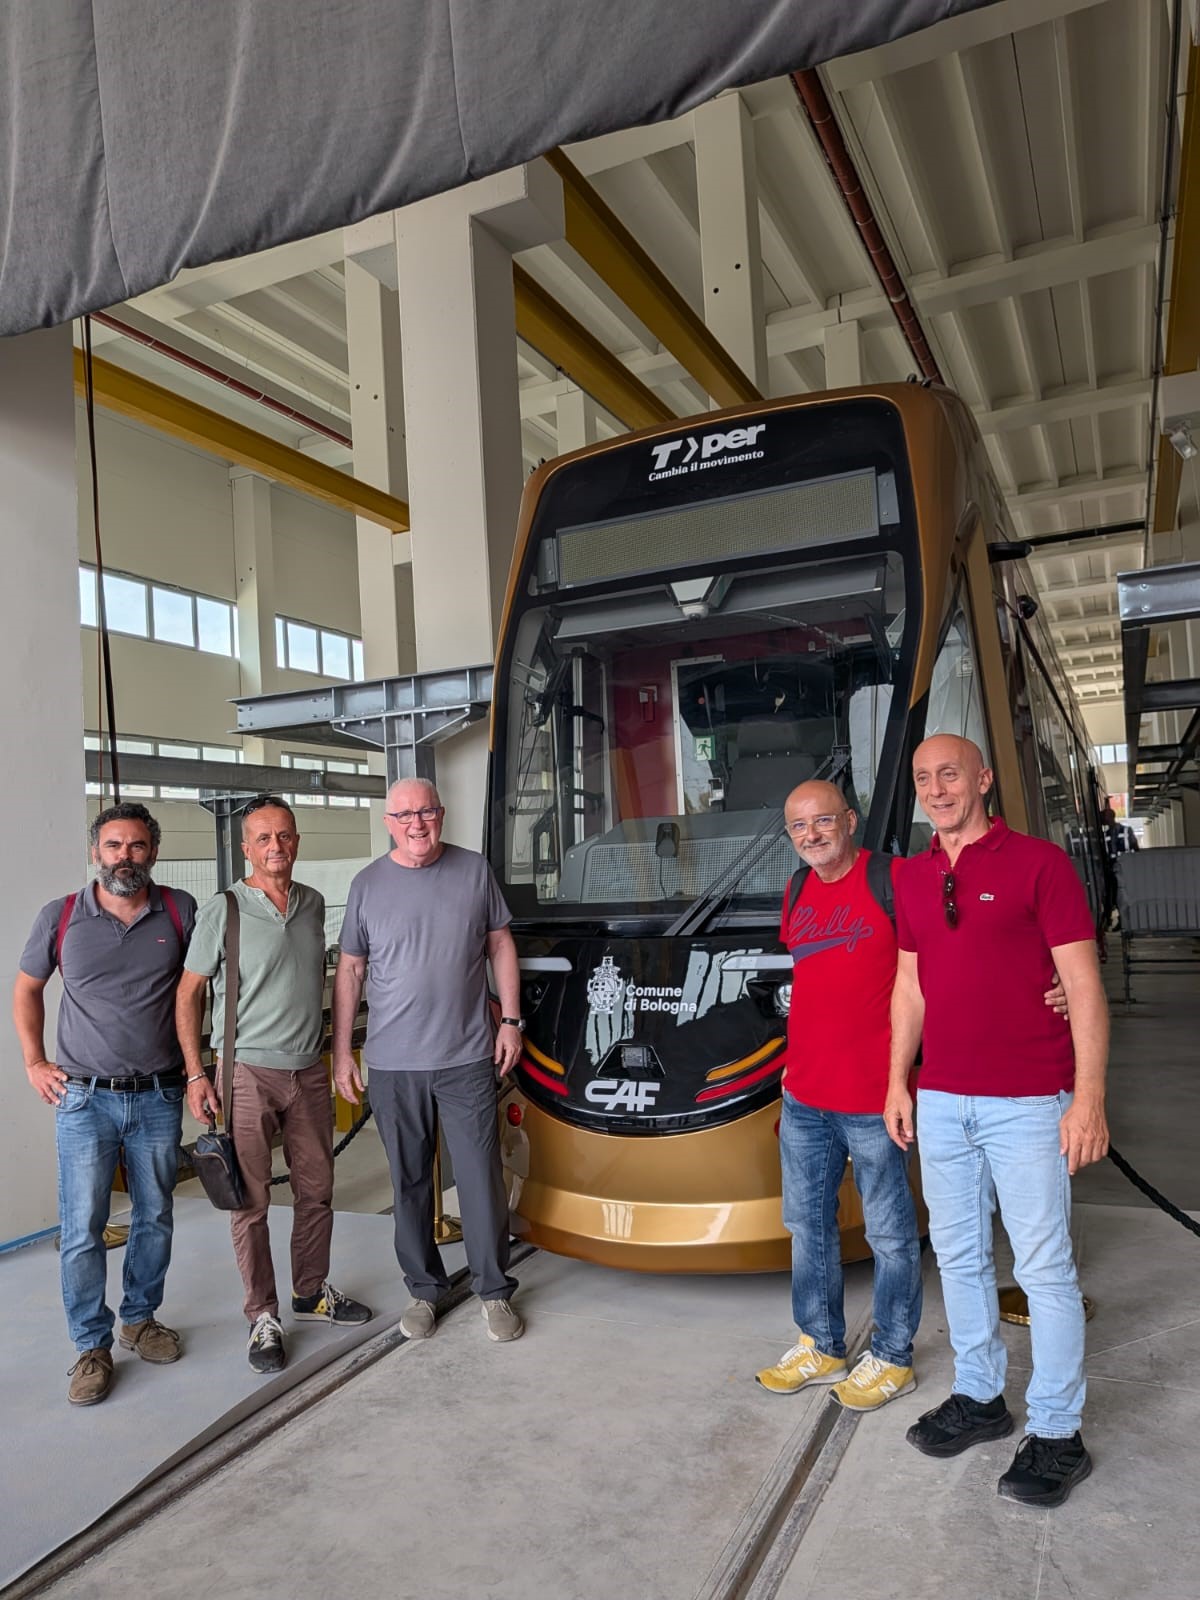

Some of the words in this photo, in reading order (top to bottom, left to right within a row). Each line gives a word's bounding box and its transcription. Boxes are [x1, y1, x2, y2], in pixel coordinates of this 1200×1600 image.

[648, 464, 688, 481] Cambia
[690, 462, 698, 472] il
[700, 450, 764, 470] movimento
[625, 984, 683, 997] Comune
[623, 999, 637, 1012] di
[640, 999, 697, 1015] Bologna
[584, 1080, 661, 1112] CAF
